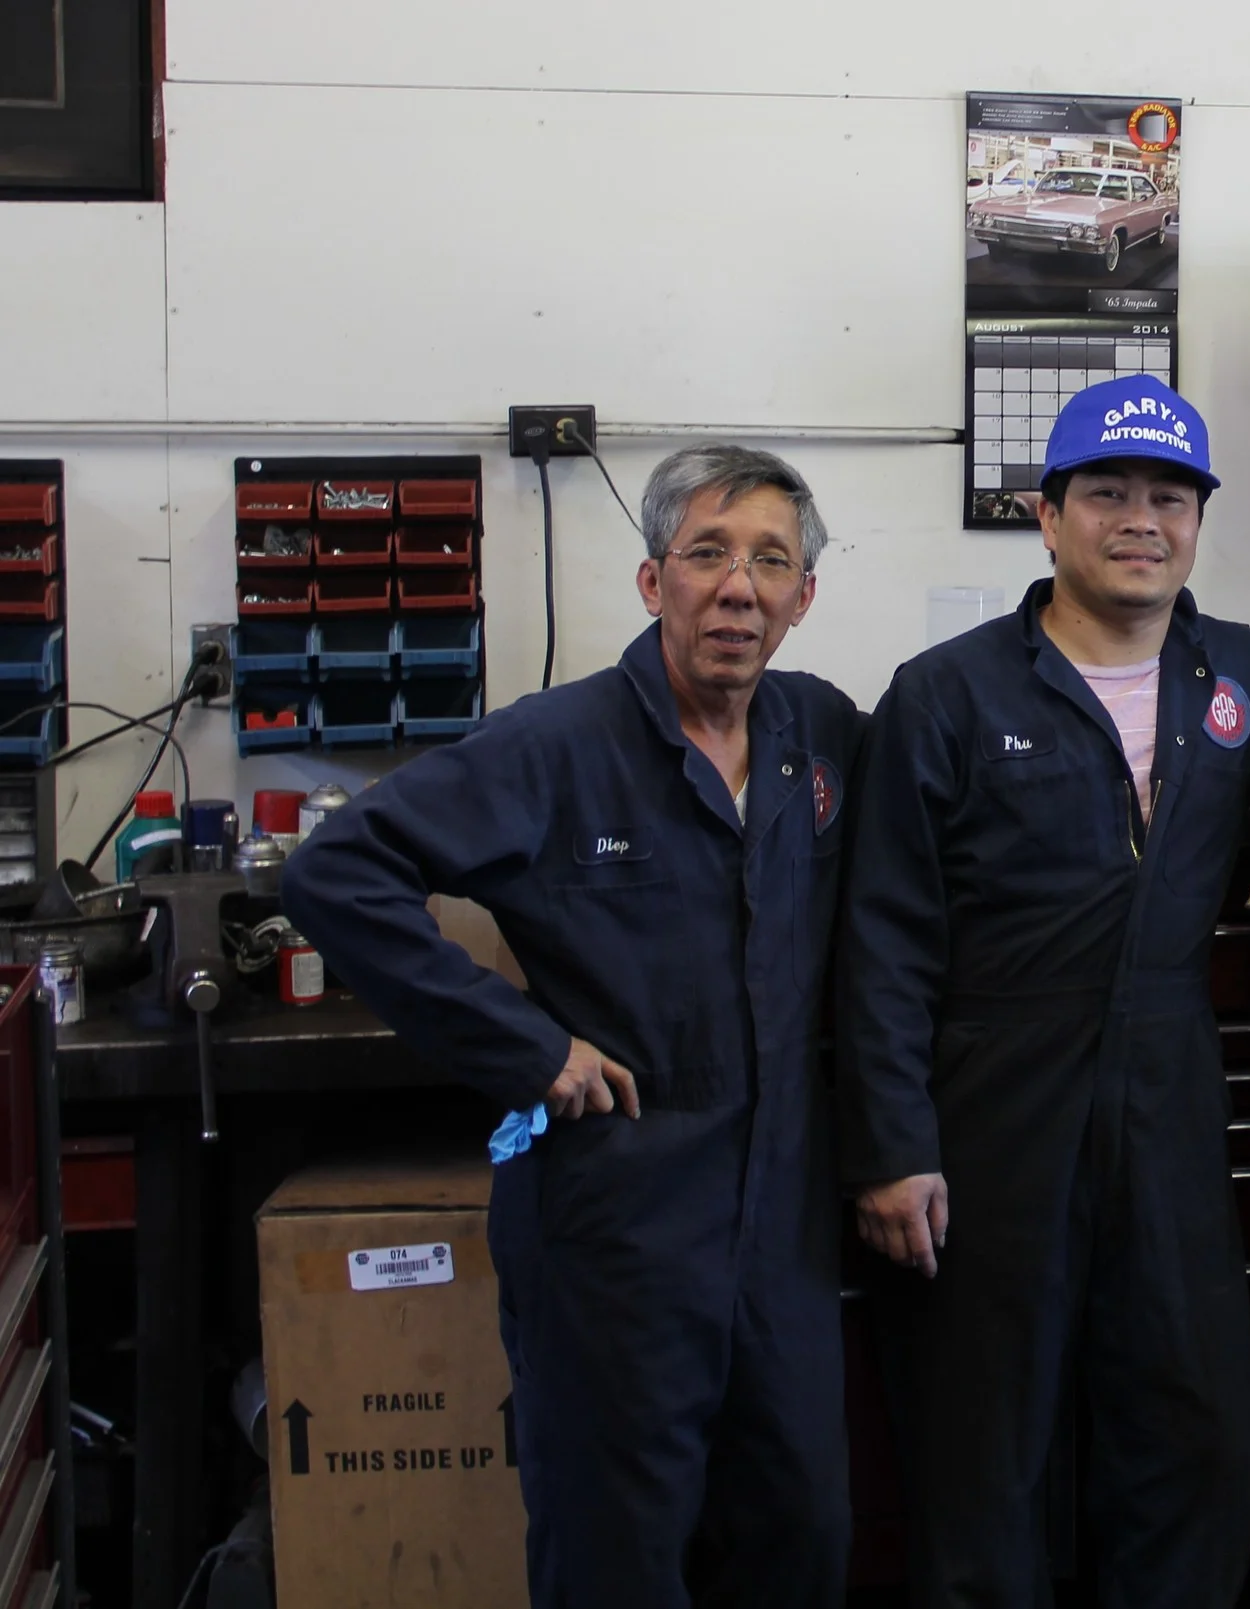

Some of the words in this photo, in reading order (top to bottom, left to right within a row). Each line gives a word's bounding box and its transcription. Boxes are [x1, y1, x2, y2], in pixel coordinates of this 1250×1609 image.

[1121, 298, 1158, 310] Impala
[1132, 325, 1170, 334] 2014
[1104, 397, 1188, 438] GARY'S
[1100, 427, 1192, 454] AUTOMOTIVE
[1211, 692, 1238, 731] GAS
[1003, 735, 1032, 750] Phu
[597, 837, 630, 854] Diep
[390, 1249, 407, 1260] 074
[363, 1392, 446, 1412] FRAGILE
[325, 1450, 385, 1473] THIS
[393, 1449, 452, 1470] SIDE
[460, 1447, 495, 1468] UP
